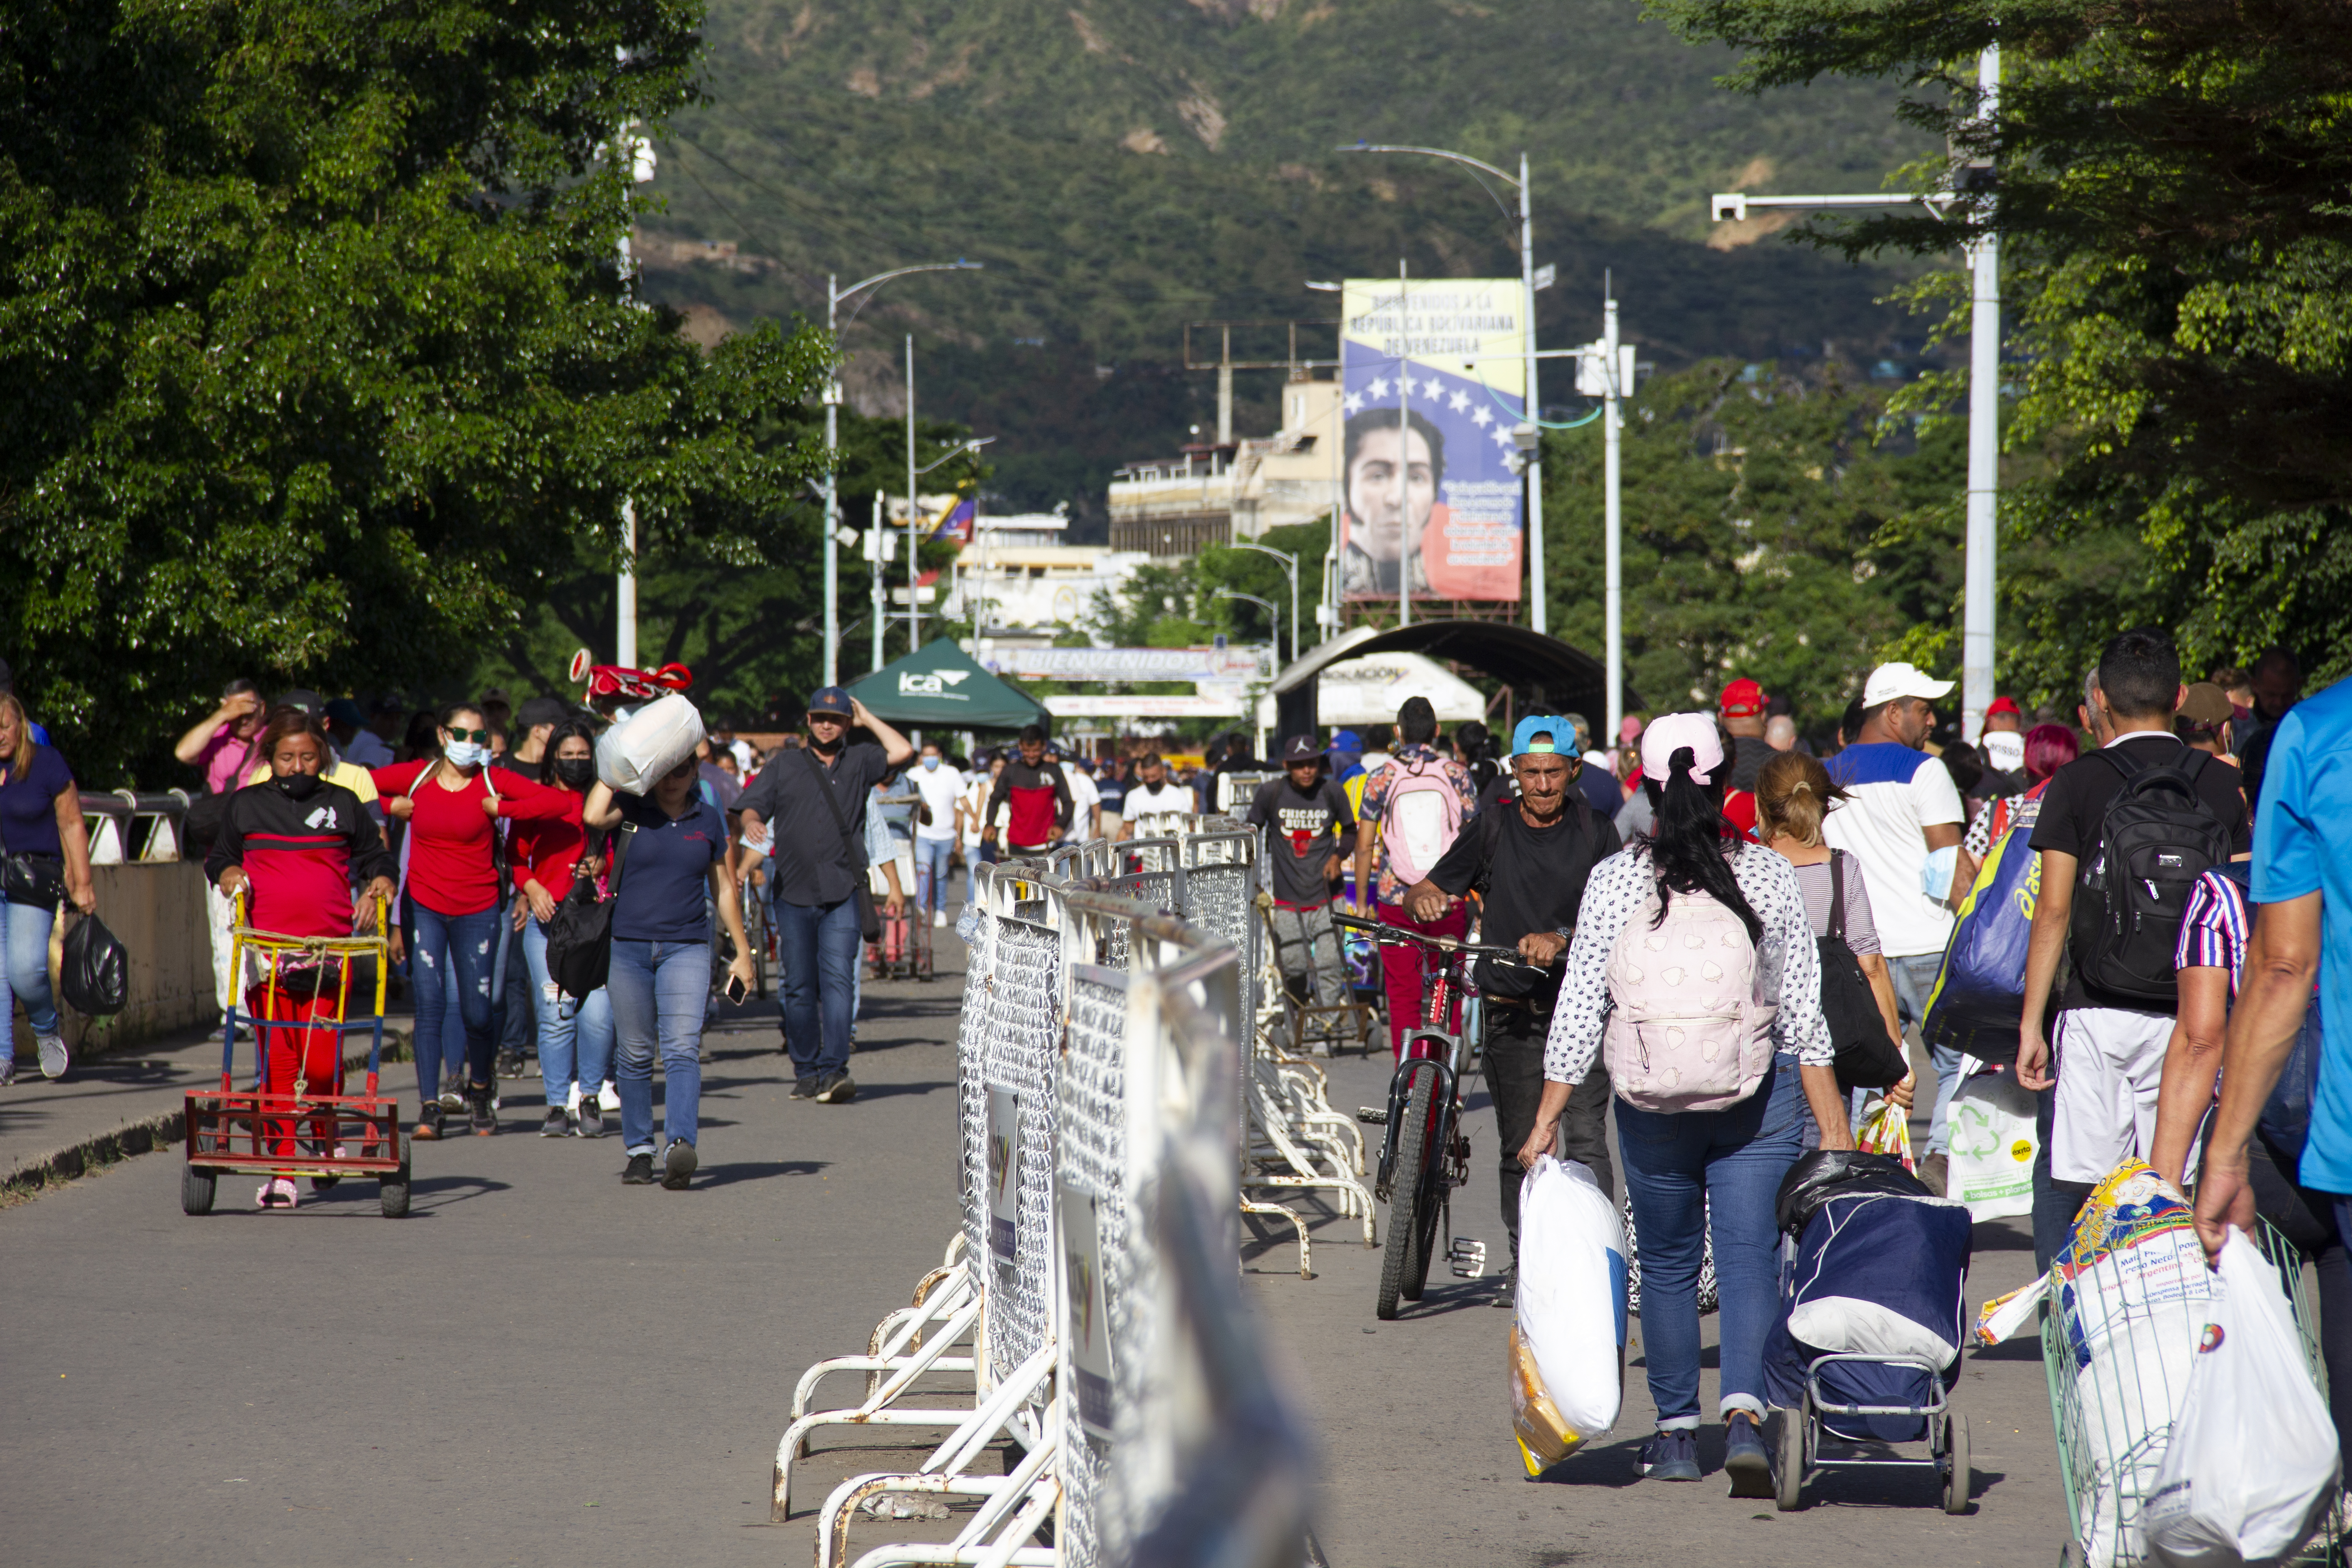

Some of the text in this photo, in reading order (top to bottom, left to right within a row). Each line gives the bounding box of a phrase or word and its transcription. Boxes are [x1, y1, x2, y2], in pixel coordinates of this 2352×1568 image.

[1430, 315, 1514, 333] BOLIVARIANA
[1385, 337, 1480, 356] DE VENEZUELA
[1027, 652, 1198, 671] BIENVENIDOS
[1279, 808, 1328, 819] CHICAGO
[1285, 818, 1321, 829] BULLS
[1429, 983, 1439, 1019] JAMIS
[2012, 1146, 2031, 1156] éxito
[1970, 1190, 1998, 1199] bolsas
[2137, 1261, 2184, 1280] Argentina
